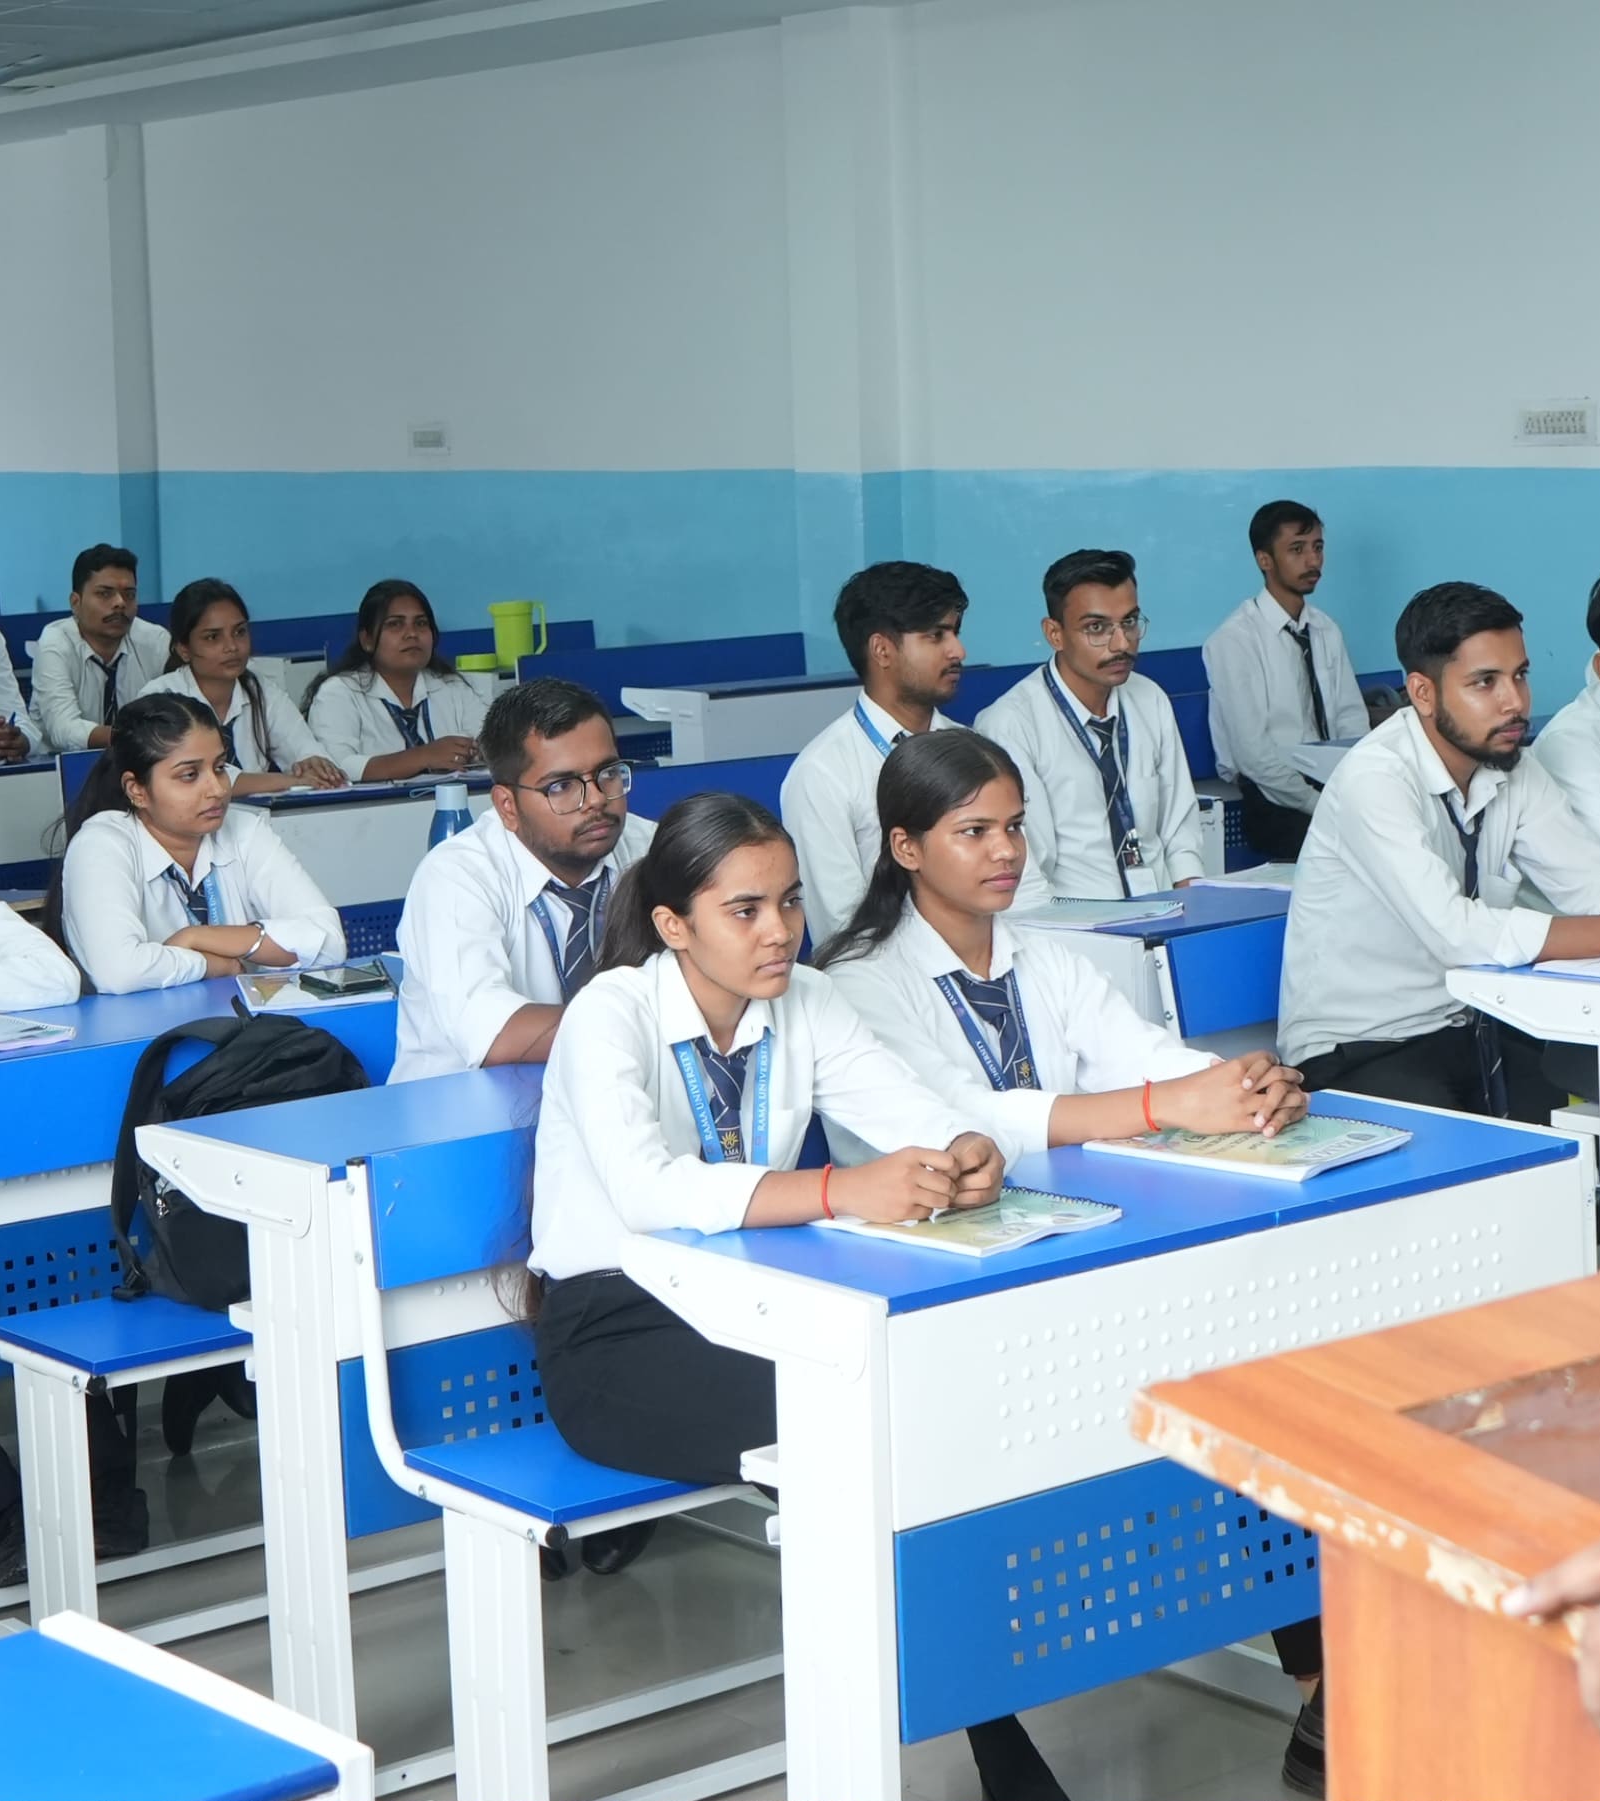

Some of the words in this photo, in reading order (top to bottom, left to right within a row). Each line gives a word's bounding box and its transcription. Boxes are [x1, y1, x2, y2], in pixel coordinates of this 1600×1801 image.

[942, 984, 958, 1007] RAMA
[974, 1039, 1002, 1082] UNIVERSITY
[677, 1049, 706, 1110] UNIVERSITY
[697, 1110, 714, 1141] RAMA
[756, 1102, 766, 1130] RAMA
